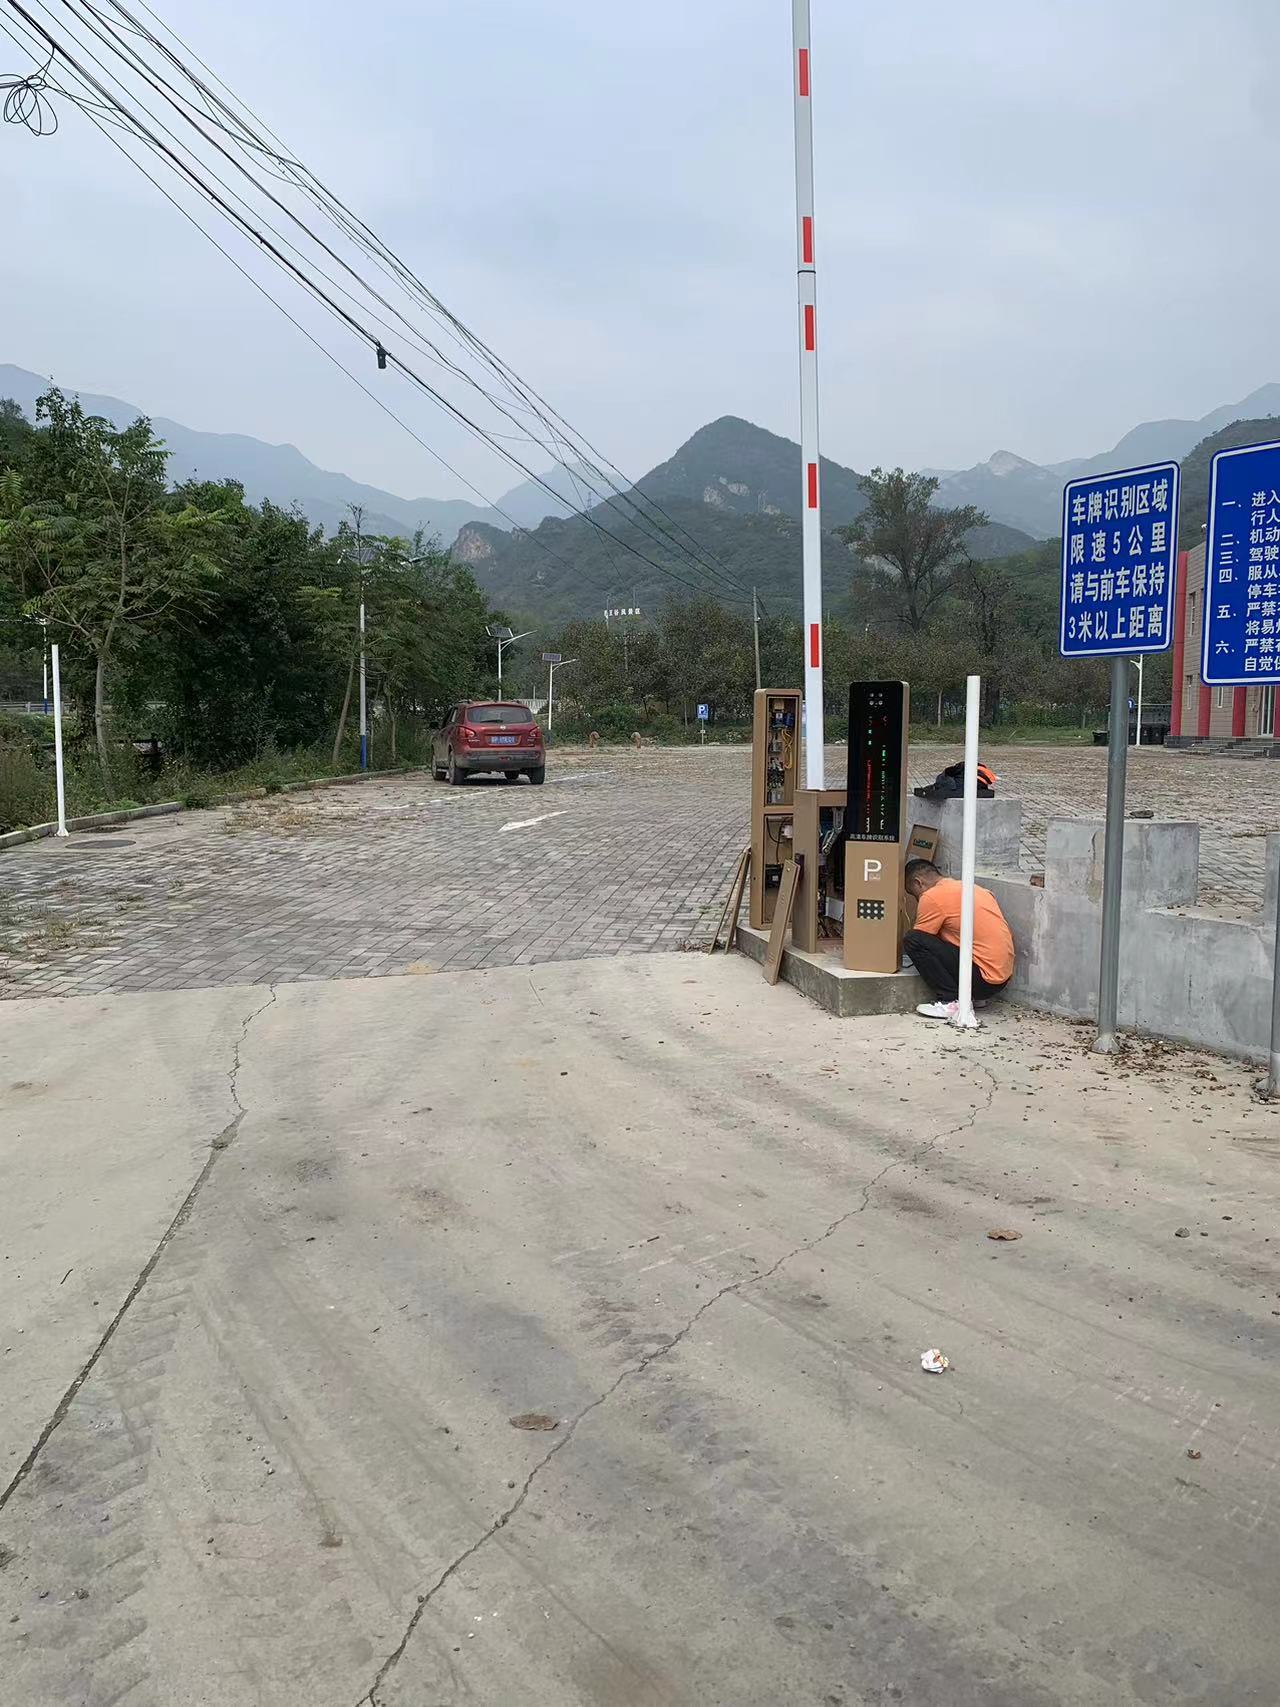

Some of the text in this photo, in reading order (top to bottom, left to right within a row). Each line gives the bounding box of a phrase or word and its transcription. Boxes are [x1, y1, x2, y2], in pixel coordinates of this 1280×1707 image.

[1071, 478, 1169, 526] 车牌识别区域
[1250, 508, 1280, 527] 行人
[1070, 521, 1167, 565] 限速5公里
[1069, 562, 1166, 604] 请与前车保持
[1218, 564, 1280, 584] 四、服从
[1247, 582, 1280, 600] 停车
[1216, 600, 1280, 619] 五、严禁
[1068, 603, 1165, 643] 3米以上距离
[864, 858, 882, 882] P
